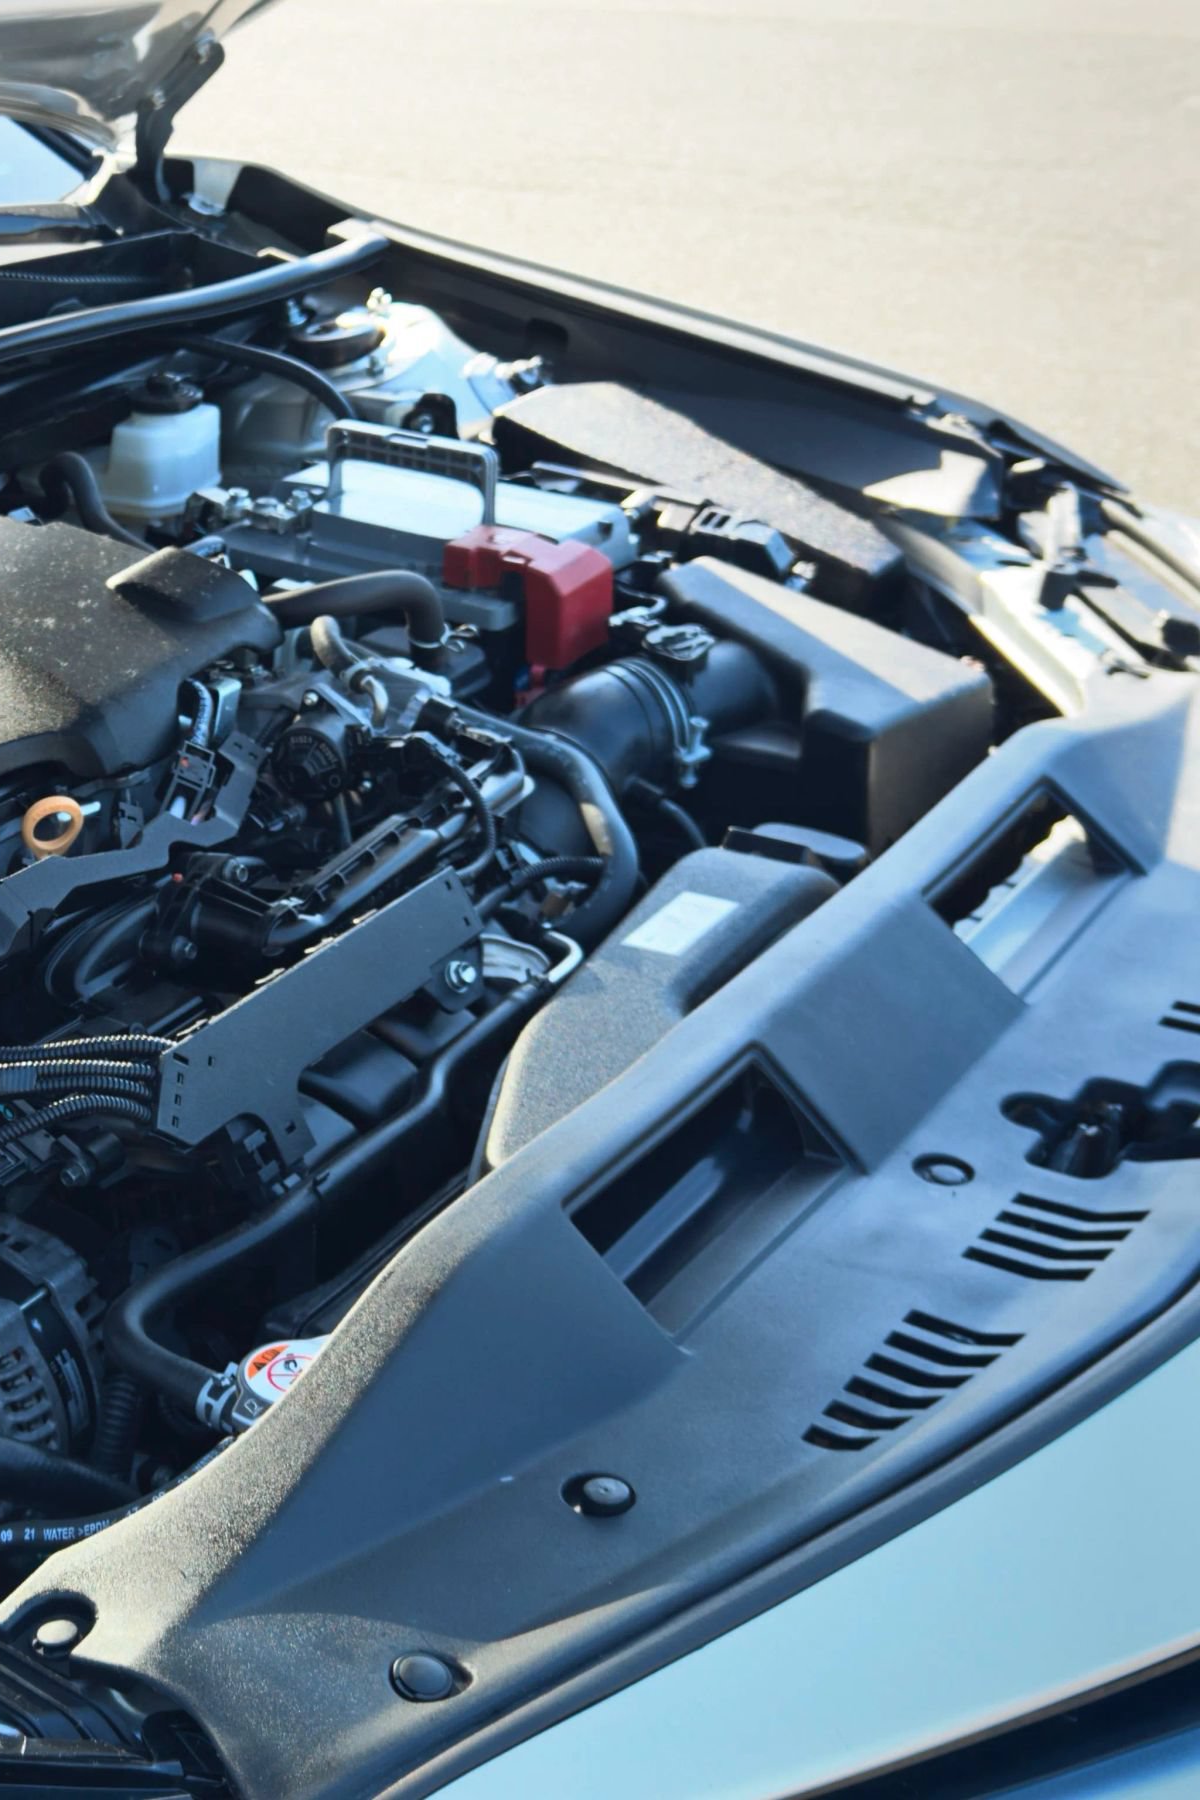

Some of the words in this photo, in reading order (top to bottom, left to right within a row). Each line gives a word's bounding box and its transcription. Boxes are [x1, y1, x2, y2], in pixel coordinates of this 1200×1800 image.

[0, 1528, 13, 1542] 09
[24, 1528, 36, 1541] 21
[43, 1526, 75, 1541] WATER
